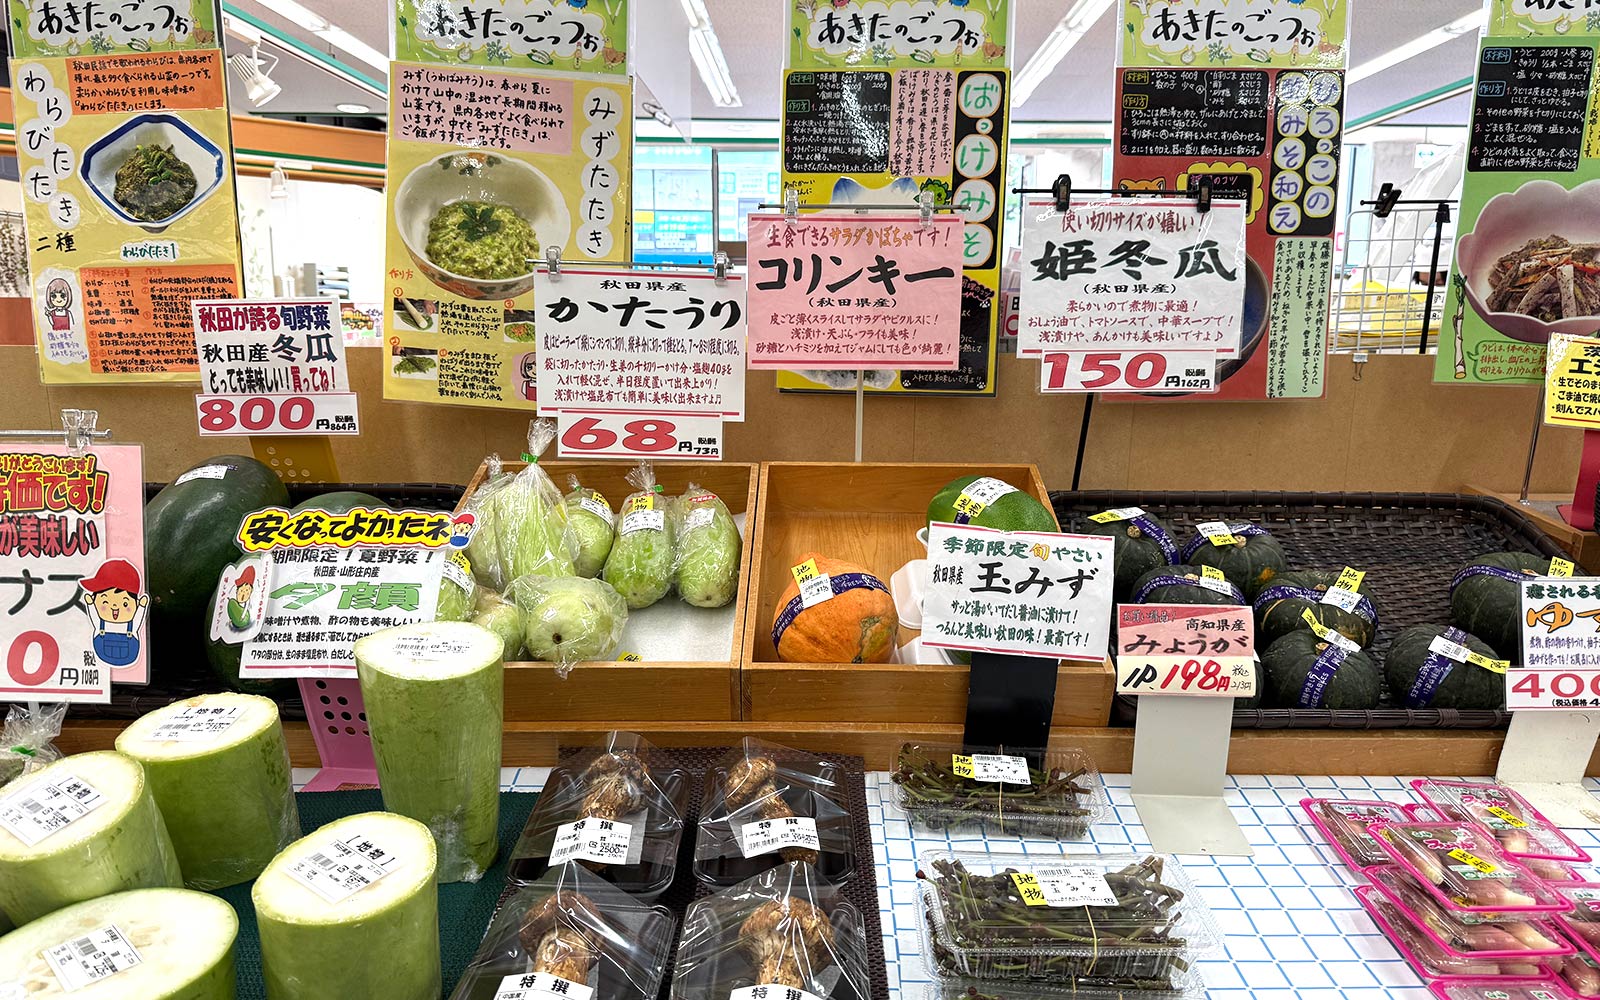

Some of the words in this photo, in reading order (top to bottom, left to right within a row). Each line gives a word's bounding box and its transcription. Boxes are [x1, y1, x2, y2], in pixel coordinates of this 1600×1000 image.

[1479, 84, 1504, 95] 作り方
[24, 71, 74, 223] わらびたたき
[587, 97, 615, 254] みずたたき
[1062, 211, 1206, 234] 使い切りサイズが嬉しい！
[36, 232, 77, 254] 二種
[766, 225, 951, 249] 生食できるサラダかぼちゃです！
[1031, 239, 1238, 283] 姫冬瓜
[389, 267, 413, 281] 作り方
[600, 279, 687, 292] 秋田県産
[755, 253, 955, 296] コリンキー
[199, 304, 331, 332] 秋田が誇る旬野菜
[545, 296, 742, 332] かたうり
[1066, 299, 1199, 314] 柔らかいので煮物に最適！
[202, 333, 338, 364] 秋田産冬瓜
[1181, 378, 1211, 389] 162円
[694, 447, 719, 456] 73円
[943, 536, 1103, 563] 季節限定旬やさい
[932, 565, 964, 586] 秋田県産
[969, 561, 1099, 600] 玉みず
[271, 581, 423, 611] 夕顔
[1186, 618, 1246, 632] 高知県産
[1124, 633, 1249, 655] みょうが
[520, 975, 570, 994] 特撰
